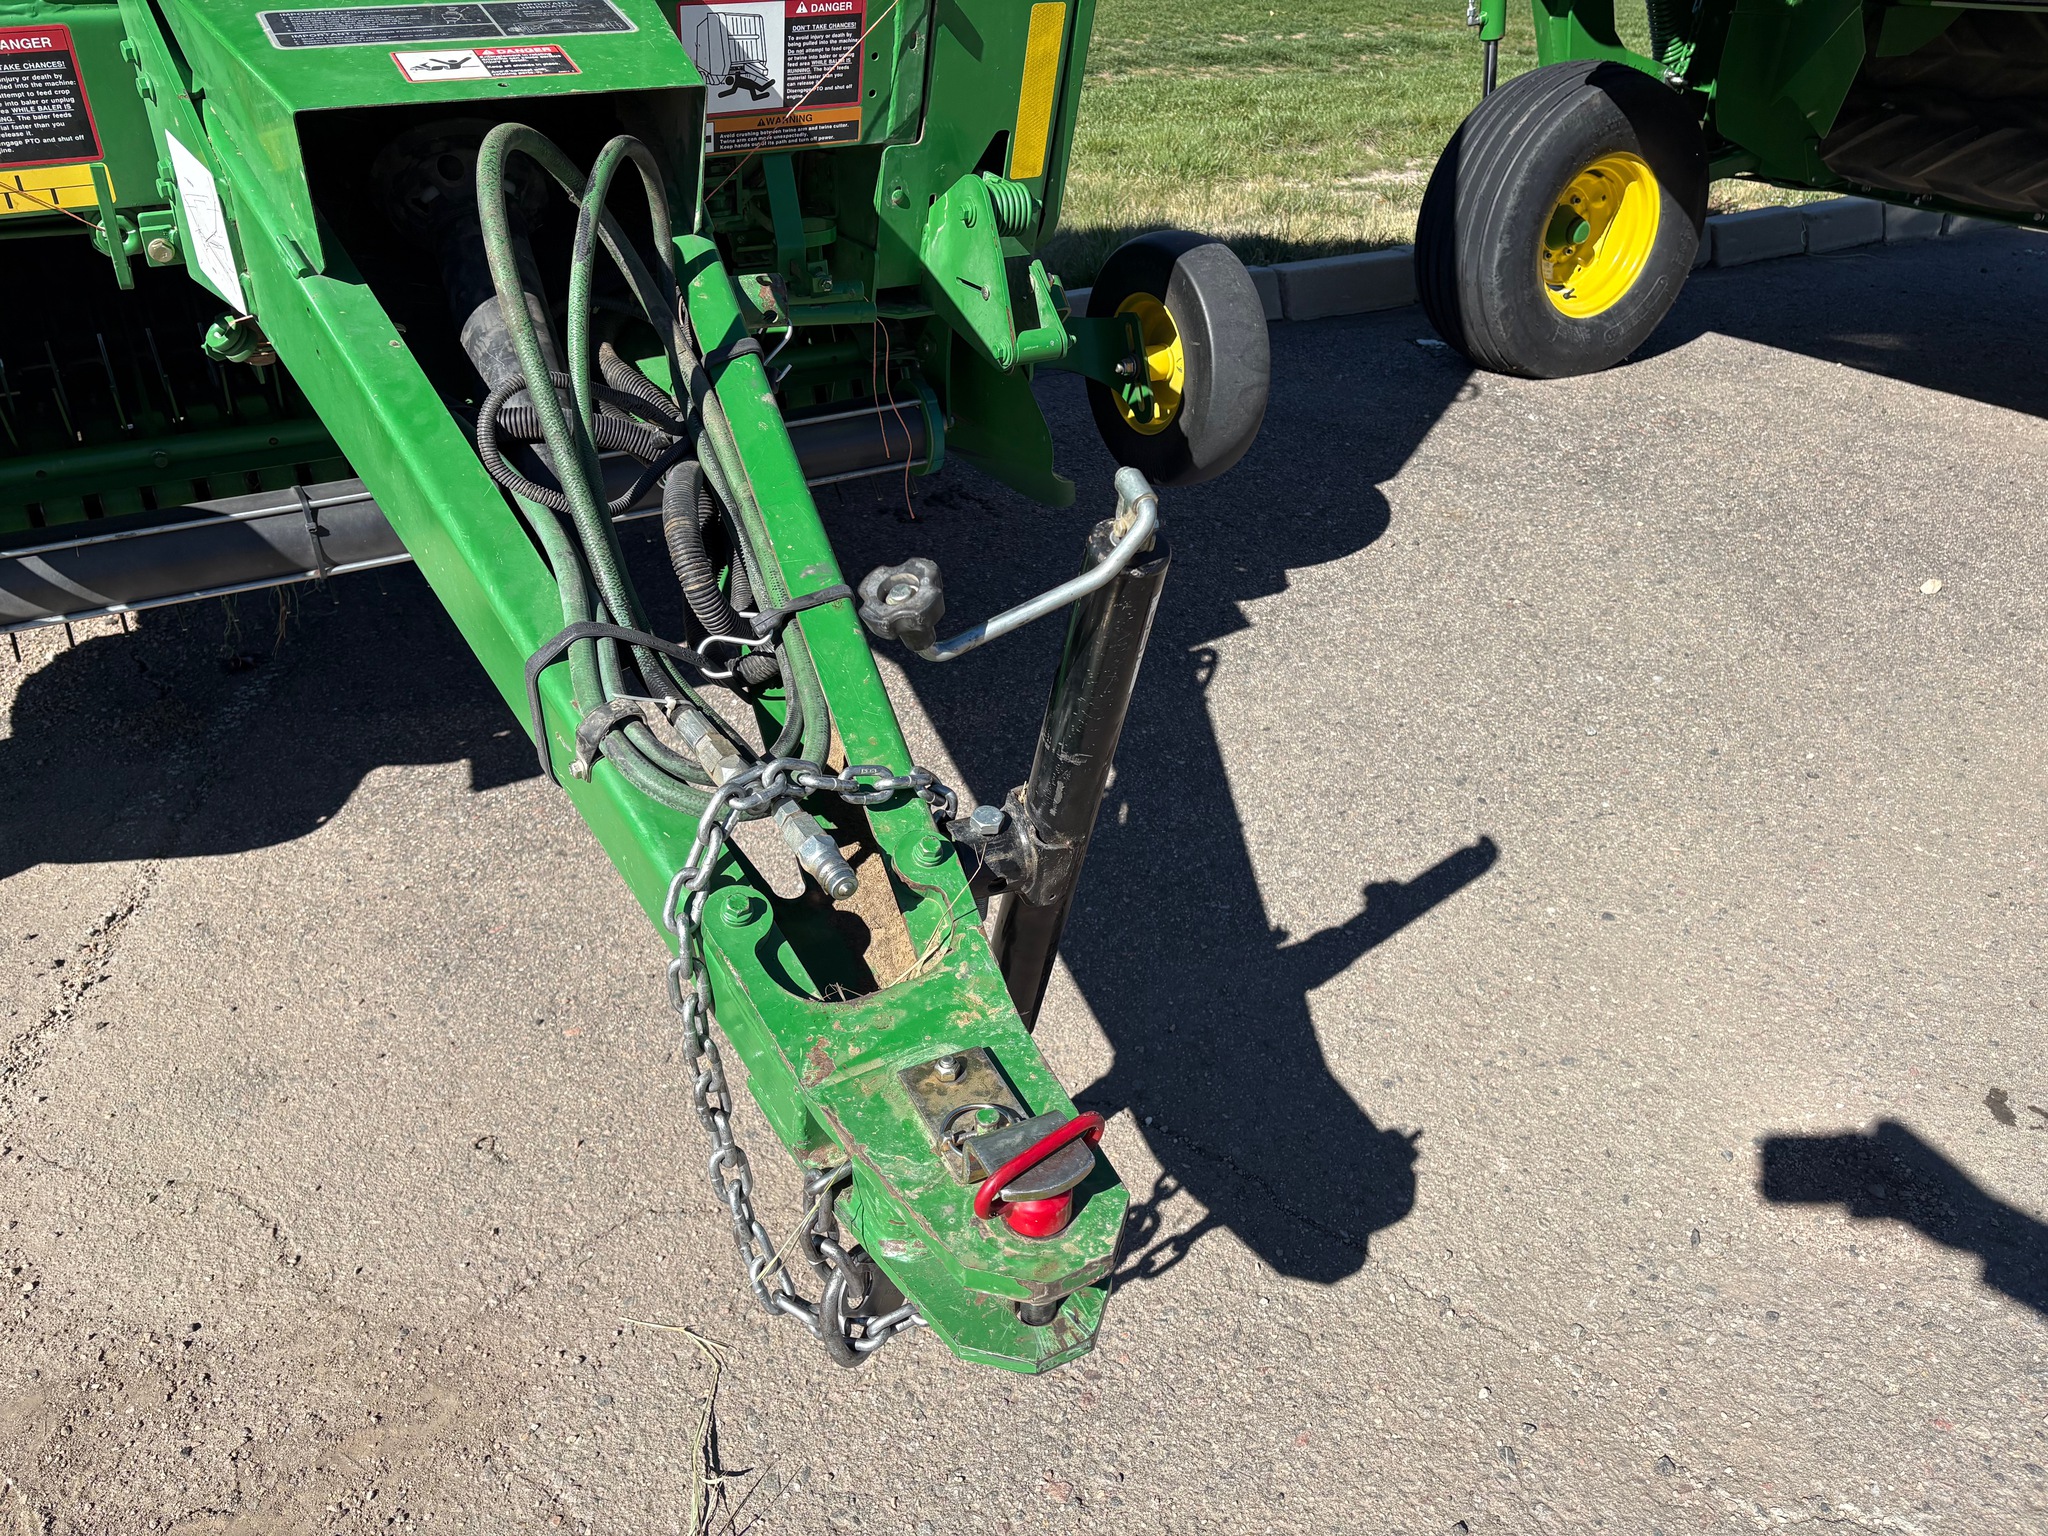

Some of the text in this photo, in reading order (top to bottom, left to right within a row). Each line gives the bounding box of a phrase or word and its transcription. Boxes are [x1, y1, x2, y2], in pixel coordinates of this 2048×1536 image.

[811, 2, 852, 12] DANGER
[23, 61, 65, 69] CHANCES!
[766, 114, 813, 125] WARNING
[704, 449, 717, 472] FLAME
